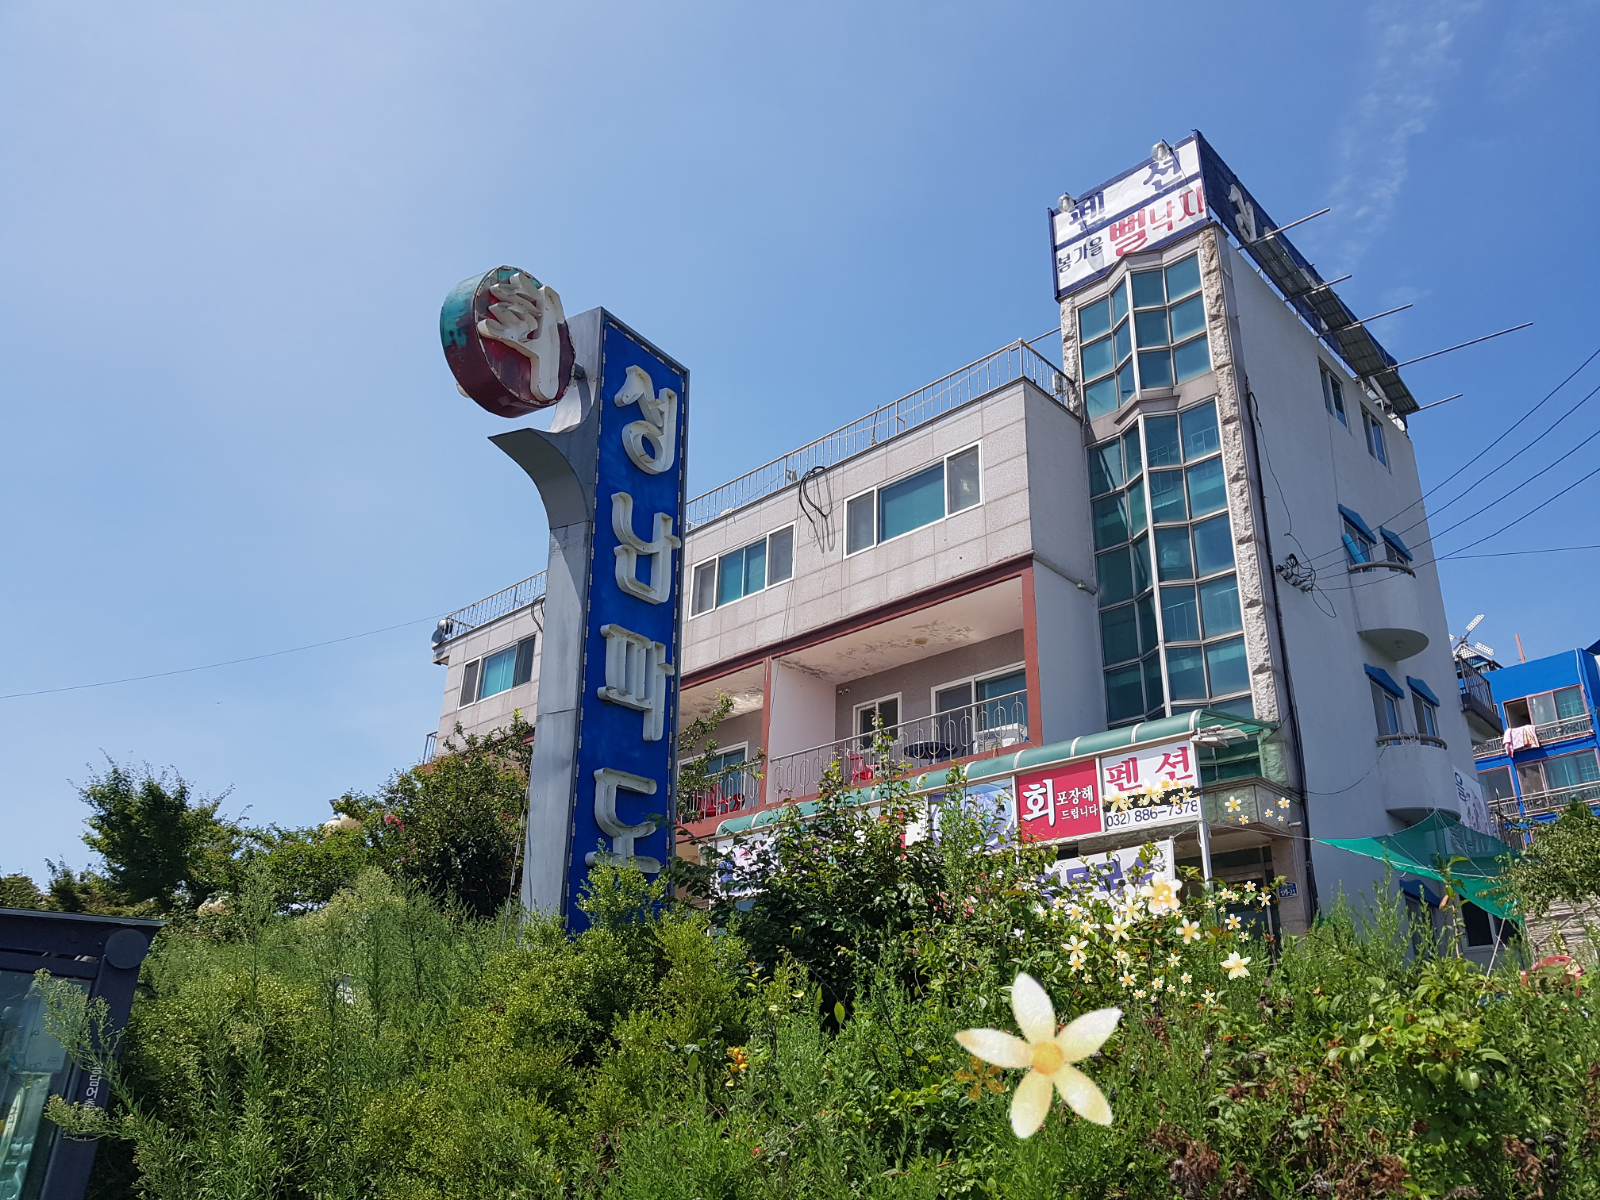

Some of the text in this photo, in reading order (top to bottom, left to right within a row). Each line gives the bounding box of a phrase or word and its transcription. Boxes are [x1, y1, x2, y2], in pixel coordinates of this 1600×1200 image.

[1109, 185, 1205, 257] 뻘낙지
[1105, 746, 1194, 792] 펜션
[1022, 778, 1056, 827] 회
[1056, 784, 1094, 806] 포장해
[1061, 803, 1099, 820] 드립니다
[1106, 812, 1131, 827] 032)
